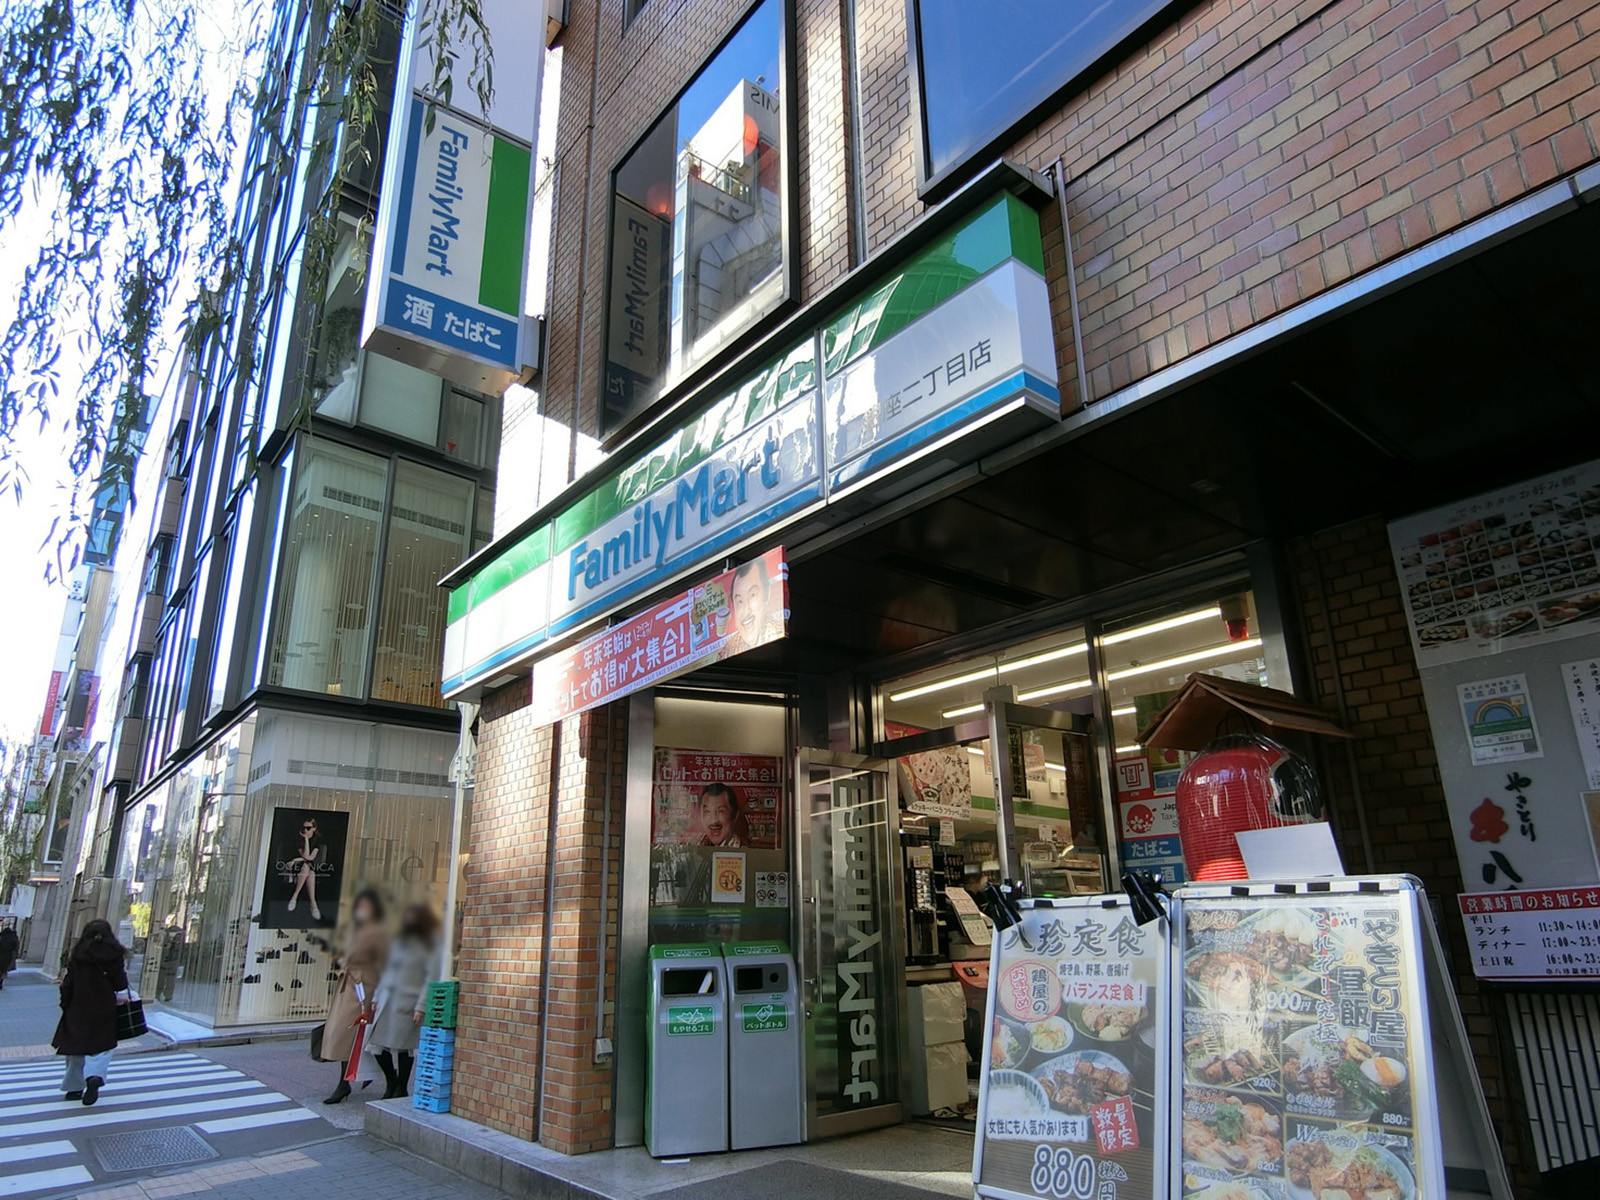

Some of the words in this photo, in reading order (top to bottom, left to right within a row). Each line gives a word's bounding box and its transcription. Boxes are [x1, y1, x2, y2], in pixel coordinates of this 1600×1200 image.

[425, 125, 469, 277] FamilyMart
[403, 293, 435, 330] 酒
[444, 311, 501, 350] たばこ
[870, 338, 991, 427] 座二丁目店
[568, 426, 780, 600] FamilyMart
[583, 632, 632, 670] 年末年始は
[549, 622, 685, 712] ットでお得が大集合!
[695, 756, 738, 767] 年末年始は
[662, 766, 775, 782] セットでお得が大集合!
[1505, 772, 1536, 841] やきとり
[1131, 841, 1172, 857] たばこ
[1466, 891, 1599, 912] 営業時間のお知らせ
[1469, 915, 1493, 924] 平日
[1475, 926, 1511, 936] ランチ
[1538, 920, 1600, 932] 11:30～14:0
[1004, 916, 1146, 957] 八珍定食
[1478, 940, 1526, 950] ディナー
[1481, 956, 1514, 966] 土日祝
[1010, 966, 1030, 1010] おすすめ
[1066, 983, 1145, 1001] バランス定食!
[673, 1025, 710, 1034] もやせるゴミ
[746, 1021, 785, 1029] ペットボトル
[1031, 1144, 1096, 1199] 880
